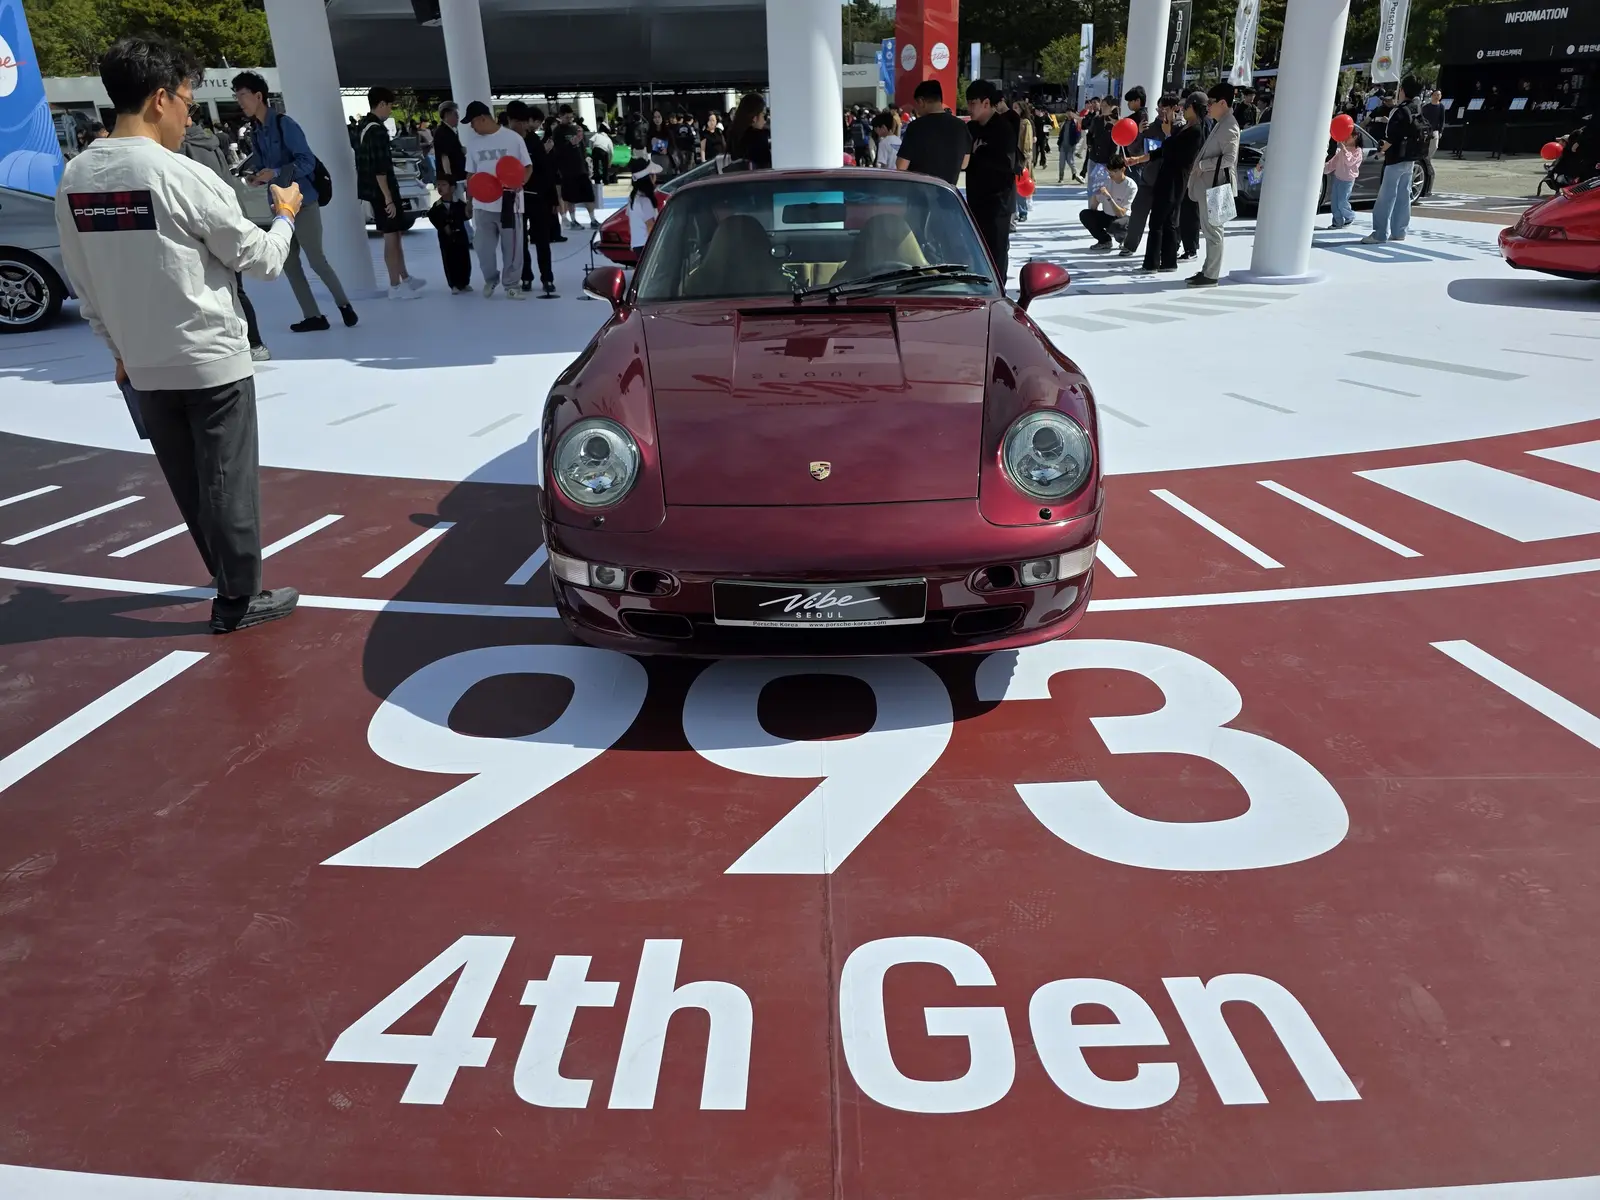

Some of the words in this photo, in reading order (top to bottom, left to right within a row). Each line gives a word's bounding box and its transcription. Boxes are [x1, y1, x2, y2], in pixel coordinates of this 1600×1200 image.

[1387, 1, 1399, 33] Porsche
[1505, 7, 1569, 23] INFORMATION
[1166, 10, 1183, 83] PORSCHE
[1385, 34, 1394, 51] Club
[74, 206, 149, 216] PORSCHE
[759, 589, 881, 612] Vibe
[796, 611, 843, 619] SEOUL
[809, 619, 887, 628] www.porsche-korea.com
[320, 638, 1351, 876] 993
[324, 934, 754, 1111] 4th
[837, 936, 1362, 1115] Gen
